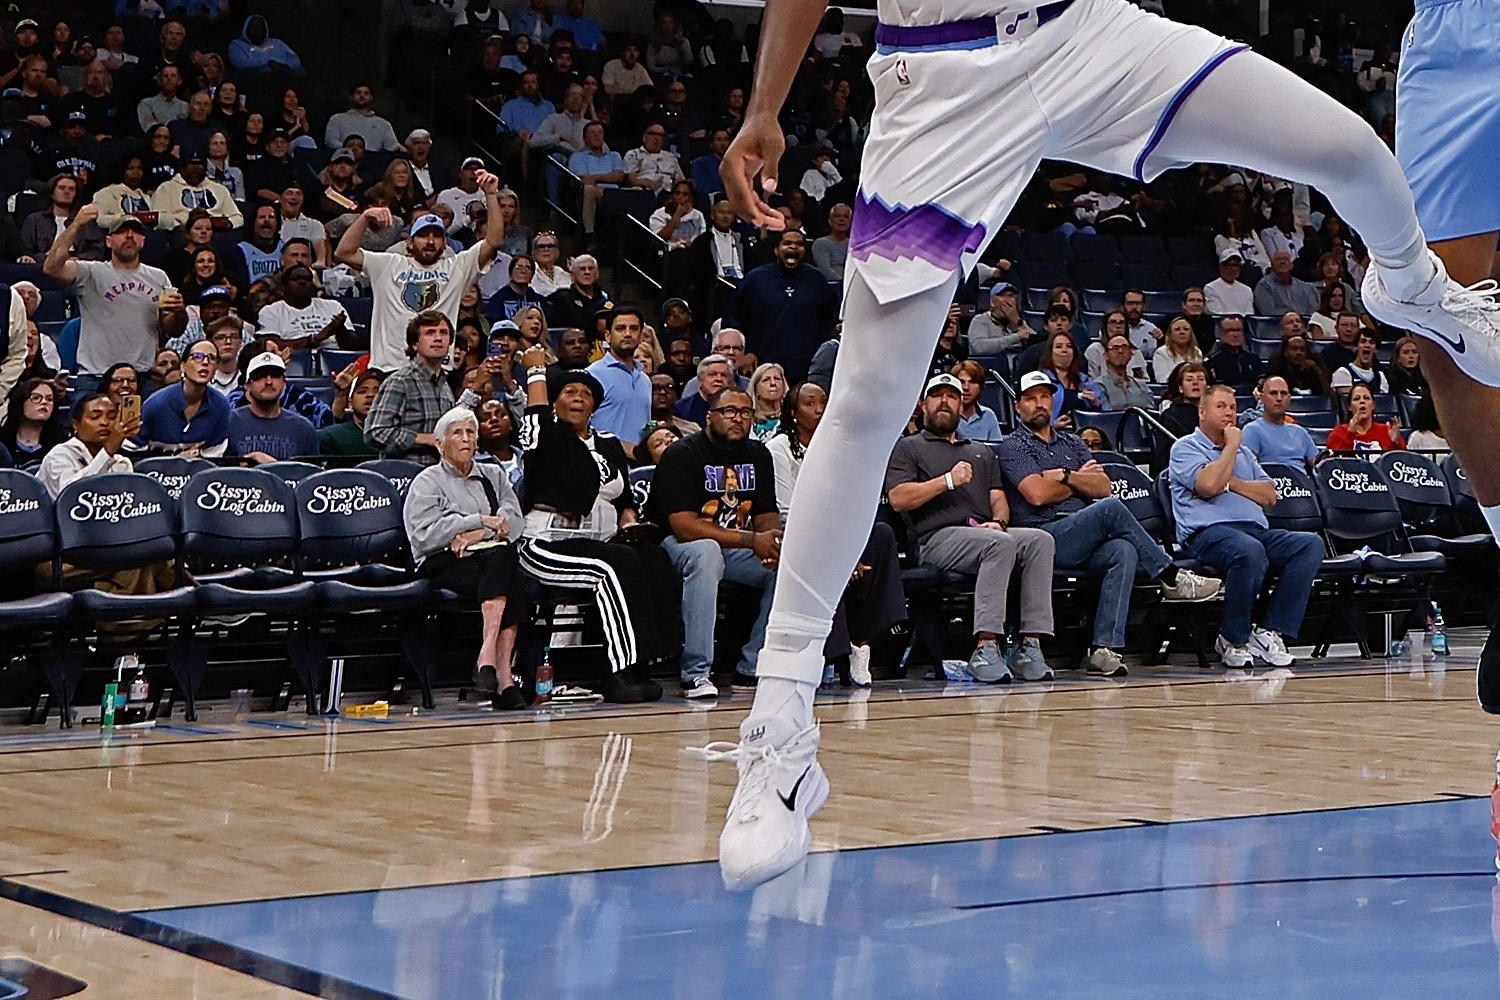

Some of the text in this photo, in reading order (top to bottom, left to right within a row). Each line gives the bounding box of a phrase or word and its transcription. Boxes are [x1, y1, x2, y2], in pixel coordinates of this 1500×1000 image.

[1328, 468, 1369, 490] Sissy's
[1389, 461, 1428, 482] Sissy's
[1404, 474, 1444, 488] Log Cabin
[197, 482, 262, 509] Sissy's
[1120, 488, 1149, 500] Cabin
[1284, 488, 1312, 498] Cabin
[1345, 481, 1388, 493] Log Cabin
[70, 490, 135, 521] Sissy's
[219, 498, 285, 516] Log Cabin
[307, 485, 366, 514] Sissy's
[329, 495, 391, 516] Log Cabin
[95, 502, 161, 523] Log Cabin
